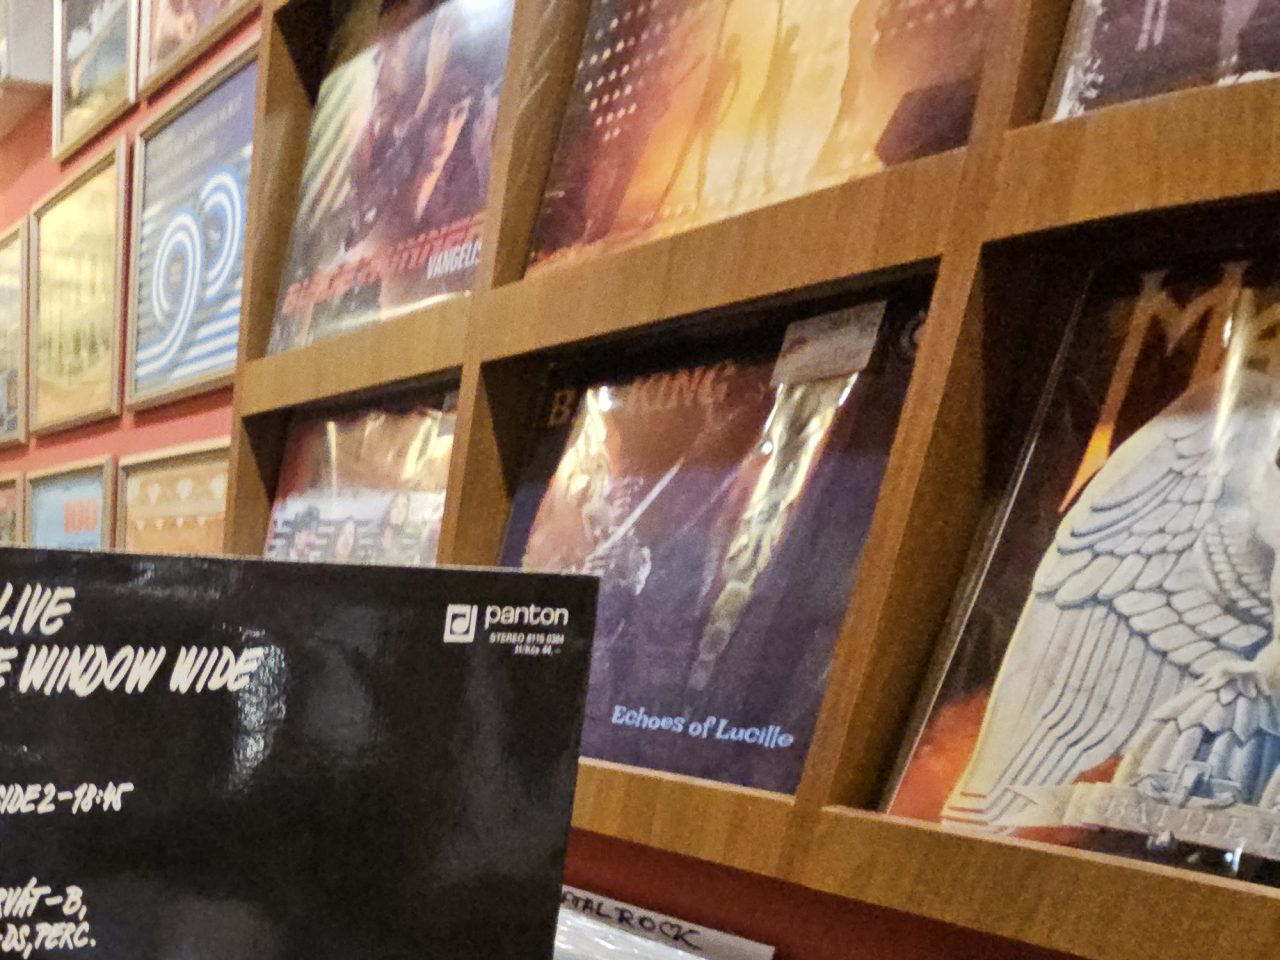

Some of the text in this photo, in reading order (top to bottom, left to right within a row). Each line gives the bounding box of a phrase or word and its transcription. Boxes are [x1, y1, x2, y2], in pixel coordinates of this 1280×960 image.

[484, 603, 569, 630] panton
[19, 643, 166, 698] WINDOW
[169, 644, 264, 694] WIDE
[611, 704, 794, 749] Echoes of Lucille
[613, 905, 704, 951] ROCK
